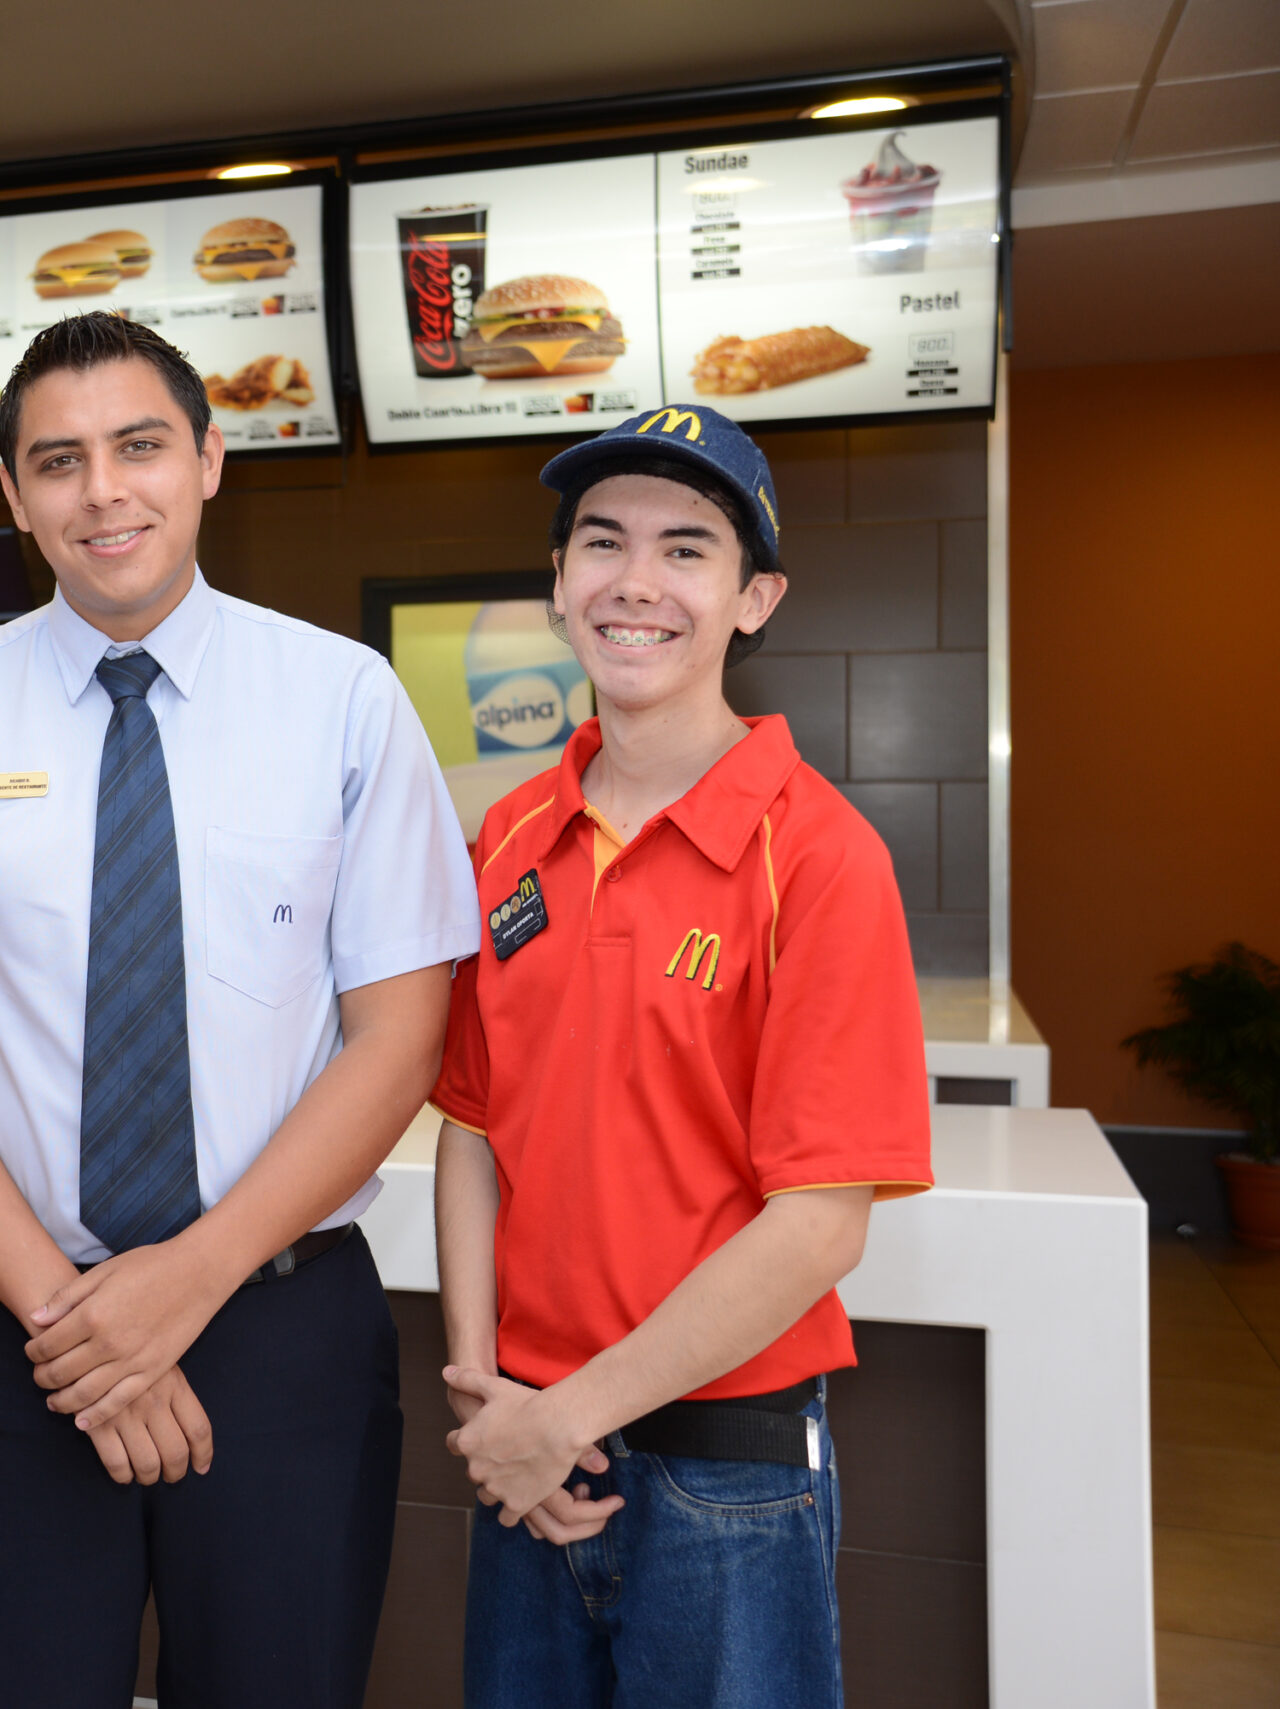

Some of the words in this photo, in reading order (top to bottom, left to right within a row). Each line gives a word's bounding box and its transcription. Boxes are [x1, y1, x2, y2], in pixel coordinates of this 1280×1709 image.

[685, 152, 749, 174] Sundae
[408, 229, 456, 371] Coca-Cola
[451, 264, 473, 339] zero
[900, 290, 961, 314] Pastel
[476, 696, 556, 732] alpina
[502, 925, 517, 940] DYLAN
